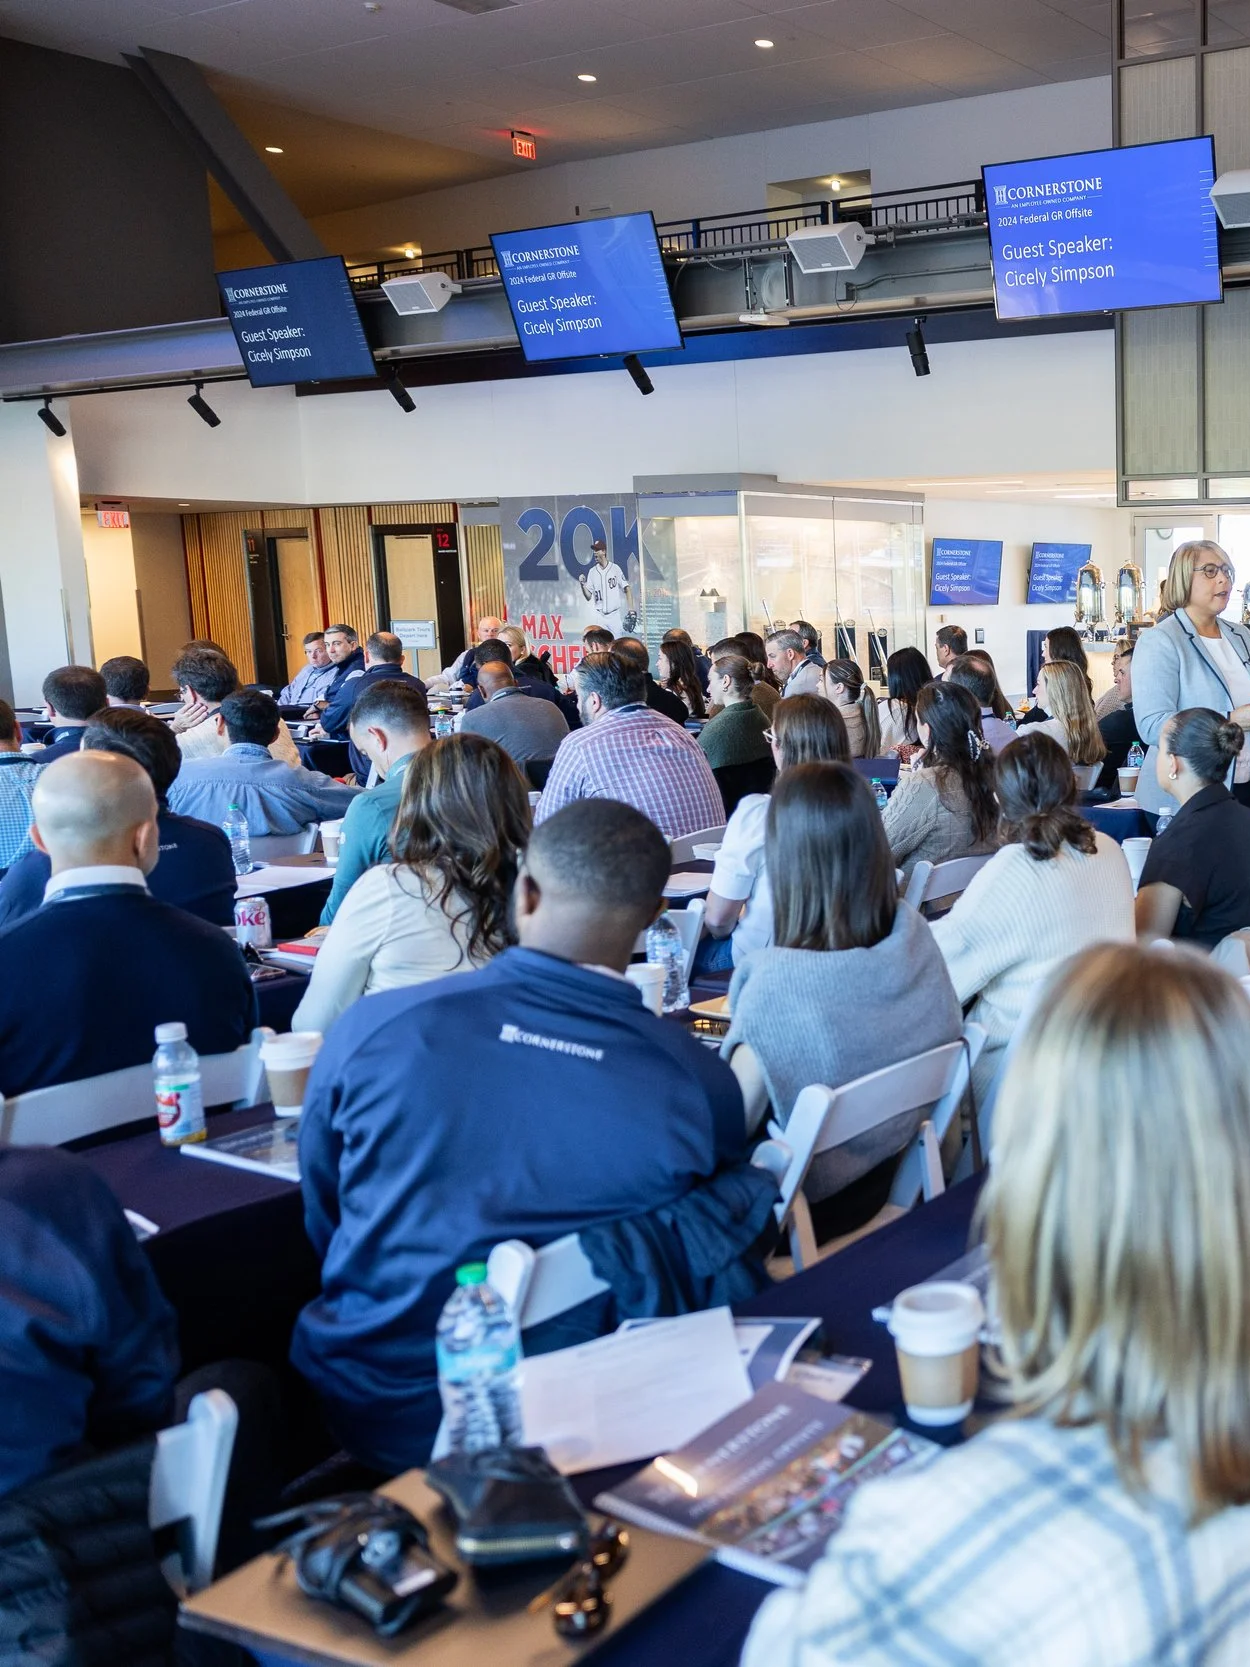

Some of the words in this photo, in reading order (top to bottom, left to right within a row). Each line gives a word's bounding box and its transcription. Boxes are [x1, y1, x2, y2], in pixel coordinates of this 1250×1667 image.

[1007, 177, 1103, 201] CORNERSTONE
[1062, 195, 1087, 204] COMPANY
[998, 215, 1018, 227] 2024
[1019, 212, 1049, 225] Federal
[1051, 210, 1063, 221] GR
[1065, 207, 1093, 219] Offsite
[511, 245, 580, 264] CORNERSTONE
[1002, 242, 1044, 260] Guest
[1048, 235, 1113, 259] Speaker:
[509, 276, 524, 285] 2024
[525, 273, 546, 284] Federal
[547, 272, 556, 280] GR
[556, 270, 577, 279] Offsite
[1005, 267, 1047, 288] Cicely
[1051, 263, 1115, 284] Simpson
[233, 283, 288, 299] CORNERSTONE
[517, 299, 549, 314] Guest
[549, 292, 597, 312] Speaker:
[241, 329, 268, 343] Guest
[268, 325, 306, 344] Speaker:
[523, 320, 554, 335] Cicely
[555, 316, 602, 333] Simpson
[247, 349, 273, 363] Cicely
[273, 346, 312, 361] Simpson
[437, 533, 450, 547] 12
[516, 505, 665, 581] 20K
[935, 573, 950, 581] Guest
[949, 584, 971, 592] Simpson
[521, 613, 564, 640] MAX
